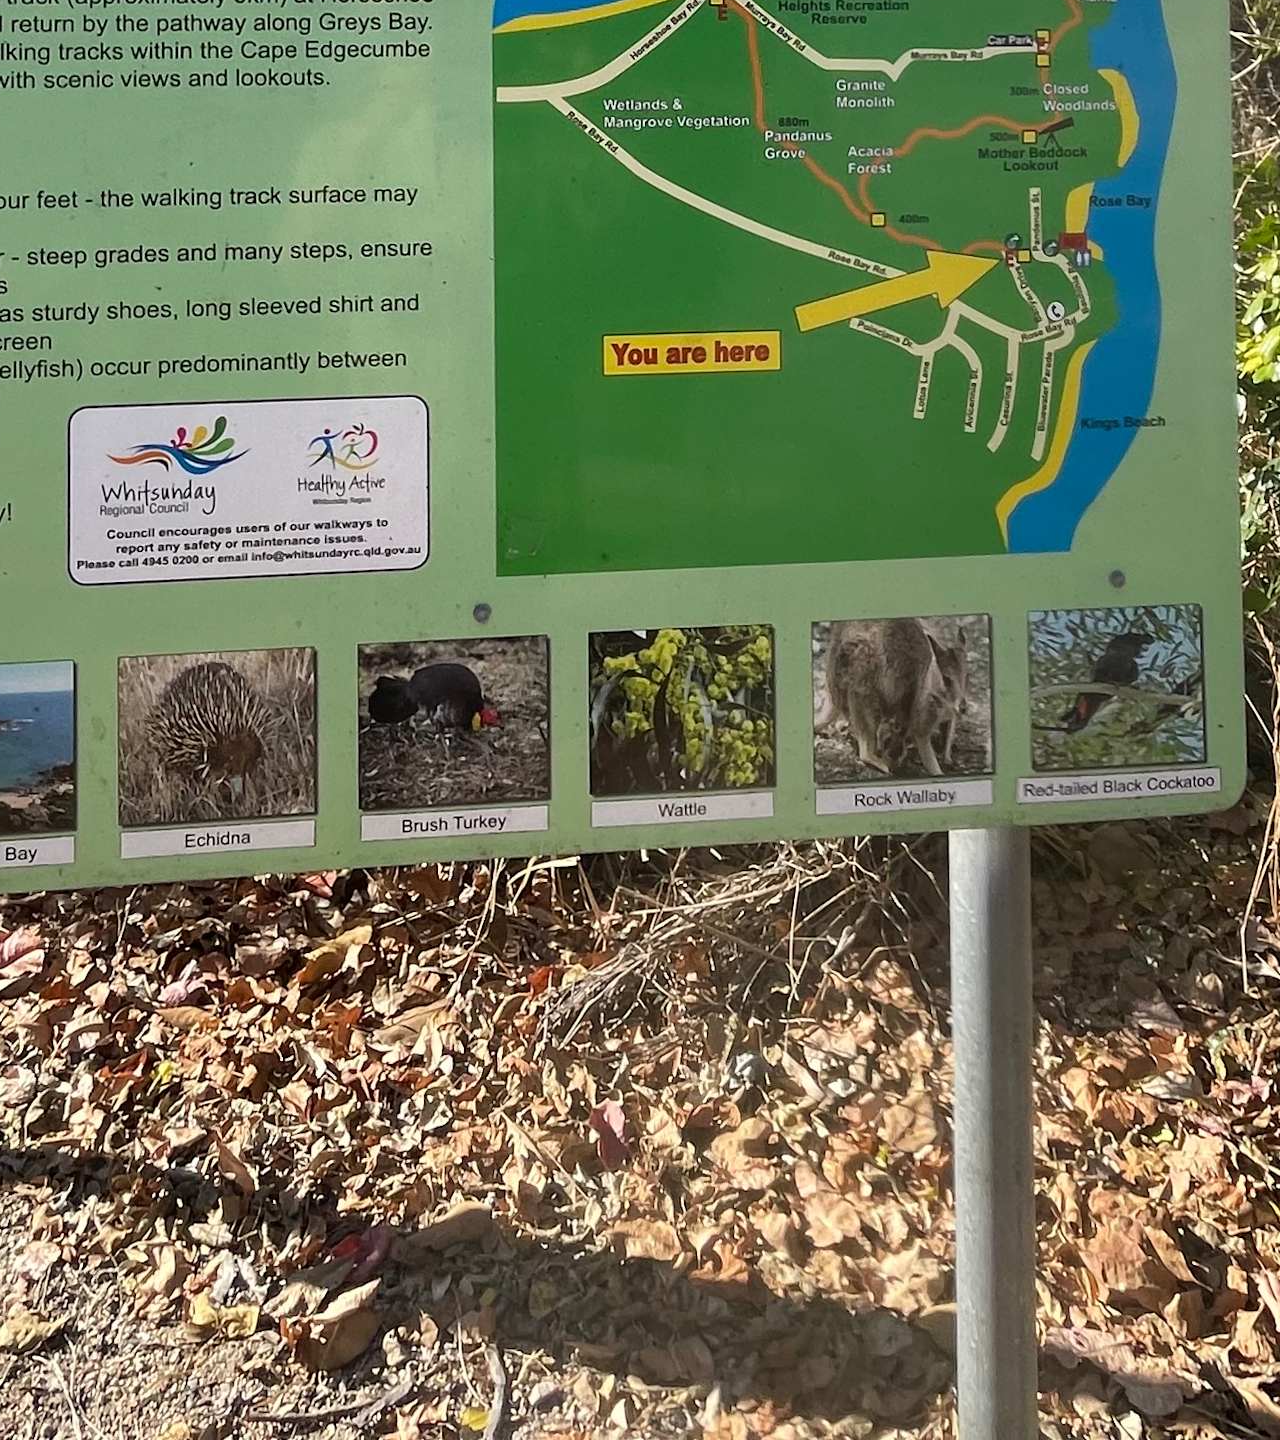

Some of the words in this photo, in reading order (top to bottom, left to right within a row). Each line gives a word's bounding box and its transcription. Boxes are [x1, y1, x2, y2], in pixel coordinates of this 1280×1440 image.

[778, 0, 831, 13] Heights
[836, 0, 909, 12] Recreation
[836, 80, 886, 91] Granite
[603, 99, 668, 111] Wetlands
[672, 98, 683, 110] &
[836, 97, 895, 108] Monolith
[604, 116, 673, 130] Mangrove
[677, 115, 750, 130] Vegetation
[764, 130, 833, 142] Pandanus
[764, 147, 805, 159] Grove
[848, 146, 894, 158] Acacia
[848, 163, 892, 175] Forest
[1090, 195, 1122, 208] Rose
[1126, 195, 1151, 208] Bay
[612, 343, 658, 366] You
[666, 346, 707, 364] are
[714, 341, 769, 363] here
[298, 473, 346, 496] Healthy
[348, 475, 385, 491] Active
[101, 480, 216, 515] Whitsunday
[100, 504, 145, 517] Regional
[149, 502, 189, 515] Council
[107, 528, 155, 539] Council
[159, 527, 231, 537] encourages
[236, 525, 270, 533] users
[274, 522, 286, 532] of
[290, 523, 310, 531] our
[314, 520, 372, 530] walkways
[377, 519, 388, 527] to
[116, 544, 154, 555] report
[158, 544, 180, 553] any
[184, 540, 221, 551] safety
[225, 541, 238, 549] or
[242, 537, 320, 547] maintenance
[325, 535, 367, 544] issues.
[77, 561, 115, 569] Please
[119, 558, 138, 568] call
[142, 556, 169, 566] 4945
[172, 555, 199, 565] 0200
[218, 553, 248, 562] email
[252, 547, 421, 562] info@whitsundayrc.qld.gov.au
[1023, 781, 1098, 797] Red-tailed
[1104, 778, 1142, 793] Black
[1147, 775, 1215, 791] Cockatoo
[854, 792, 892, 807] Rock
[897, 789, 956, 804] Wallaby
[659, 803, 707, 817] Wattle
[402, 819, 448, 833] Brush
[453, 815, 506, 832] Turkey
[185, 832, 251, 848] Echidna
[5, 846, 38, 863] Bay
